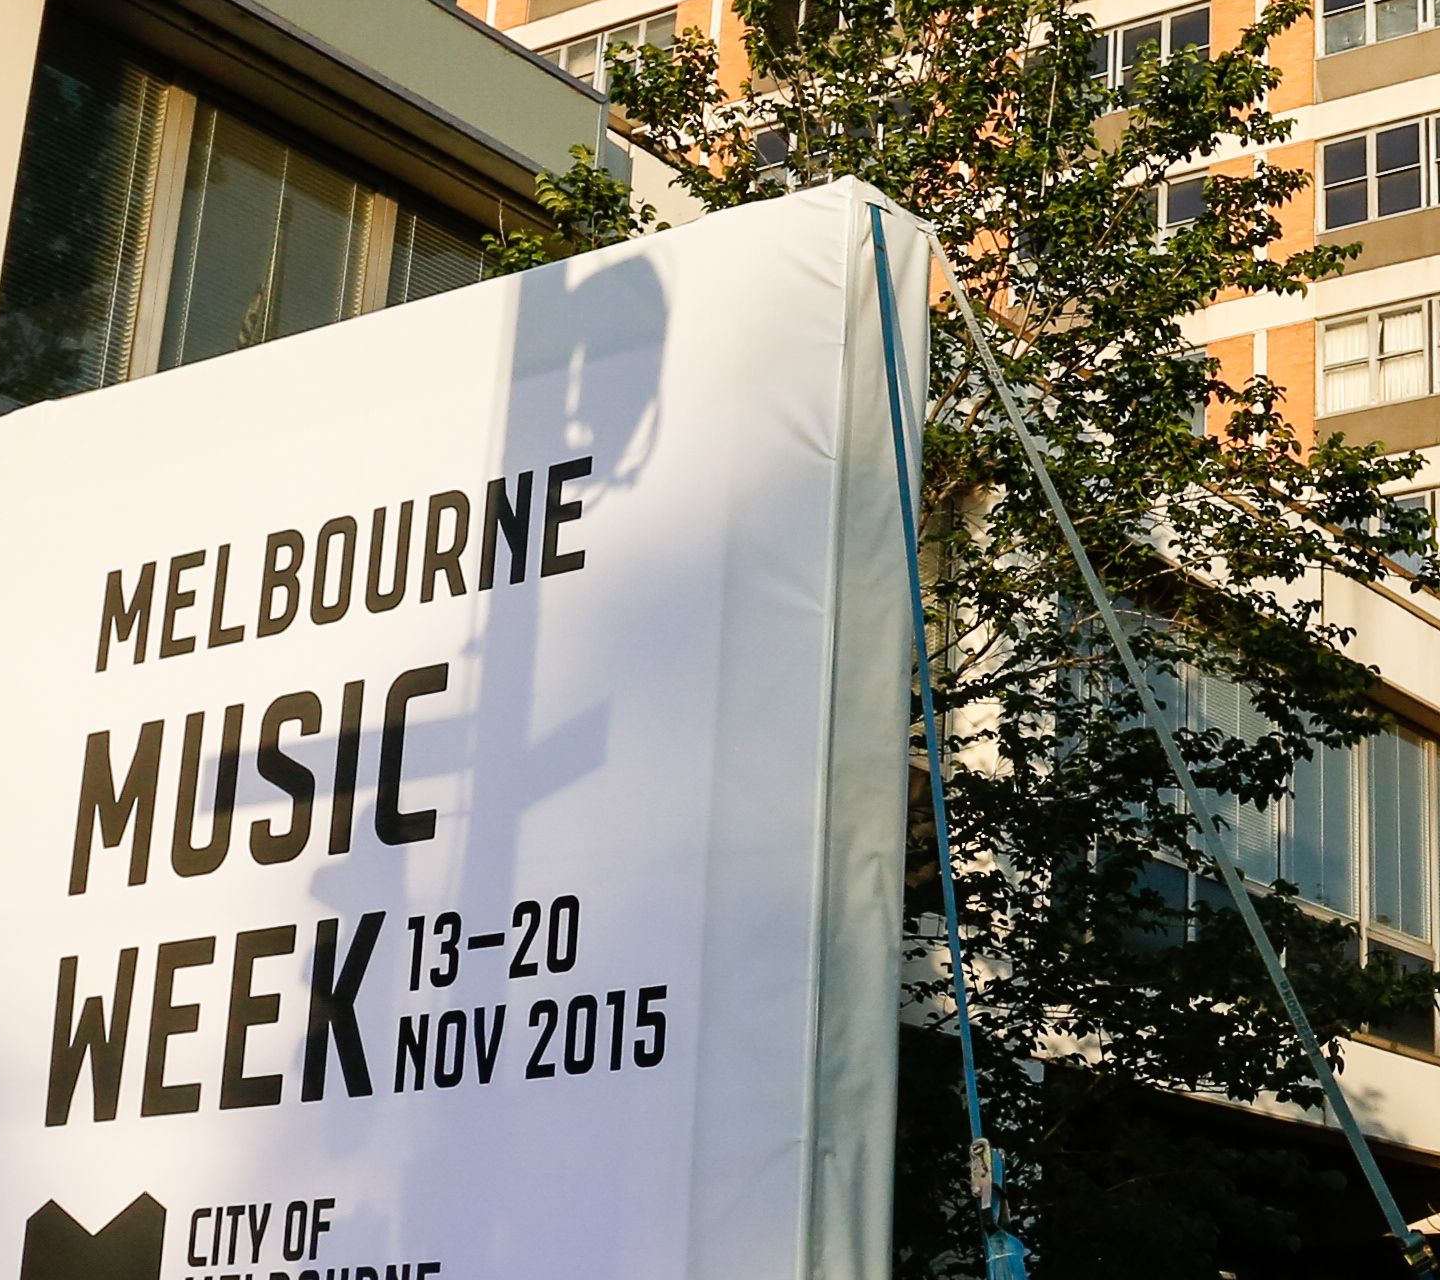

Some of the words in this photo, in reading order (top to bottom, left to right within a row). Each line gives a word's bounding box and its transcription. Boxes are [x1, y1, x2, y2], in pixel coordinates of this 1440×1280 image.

[95, 456, 594, 672] MELBOURNE
[68, 663, 449, 895] MUSIC
[45, 912, 385, 1127] WEEK
[395, 1005, 509, 1093] NOV
[527, 986, 666, 1080] 2015
[187, 1203, 271, 1267] CITY
[282, 1198, 336, 1261] OF
